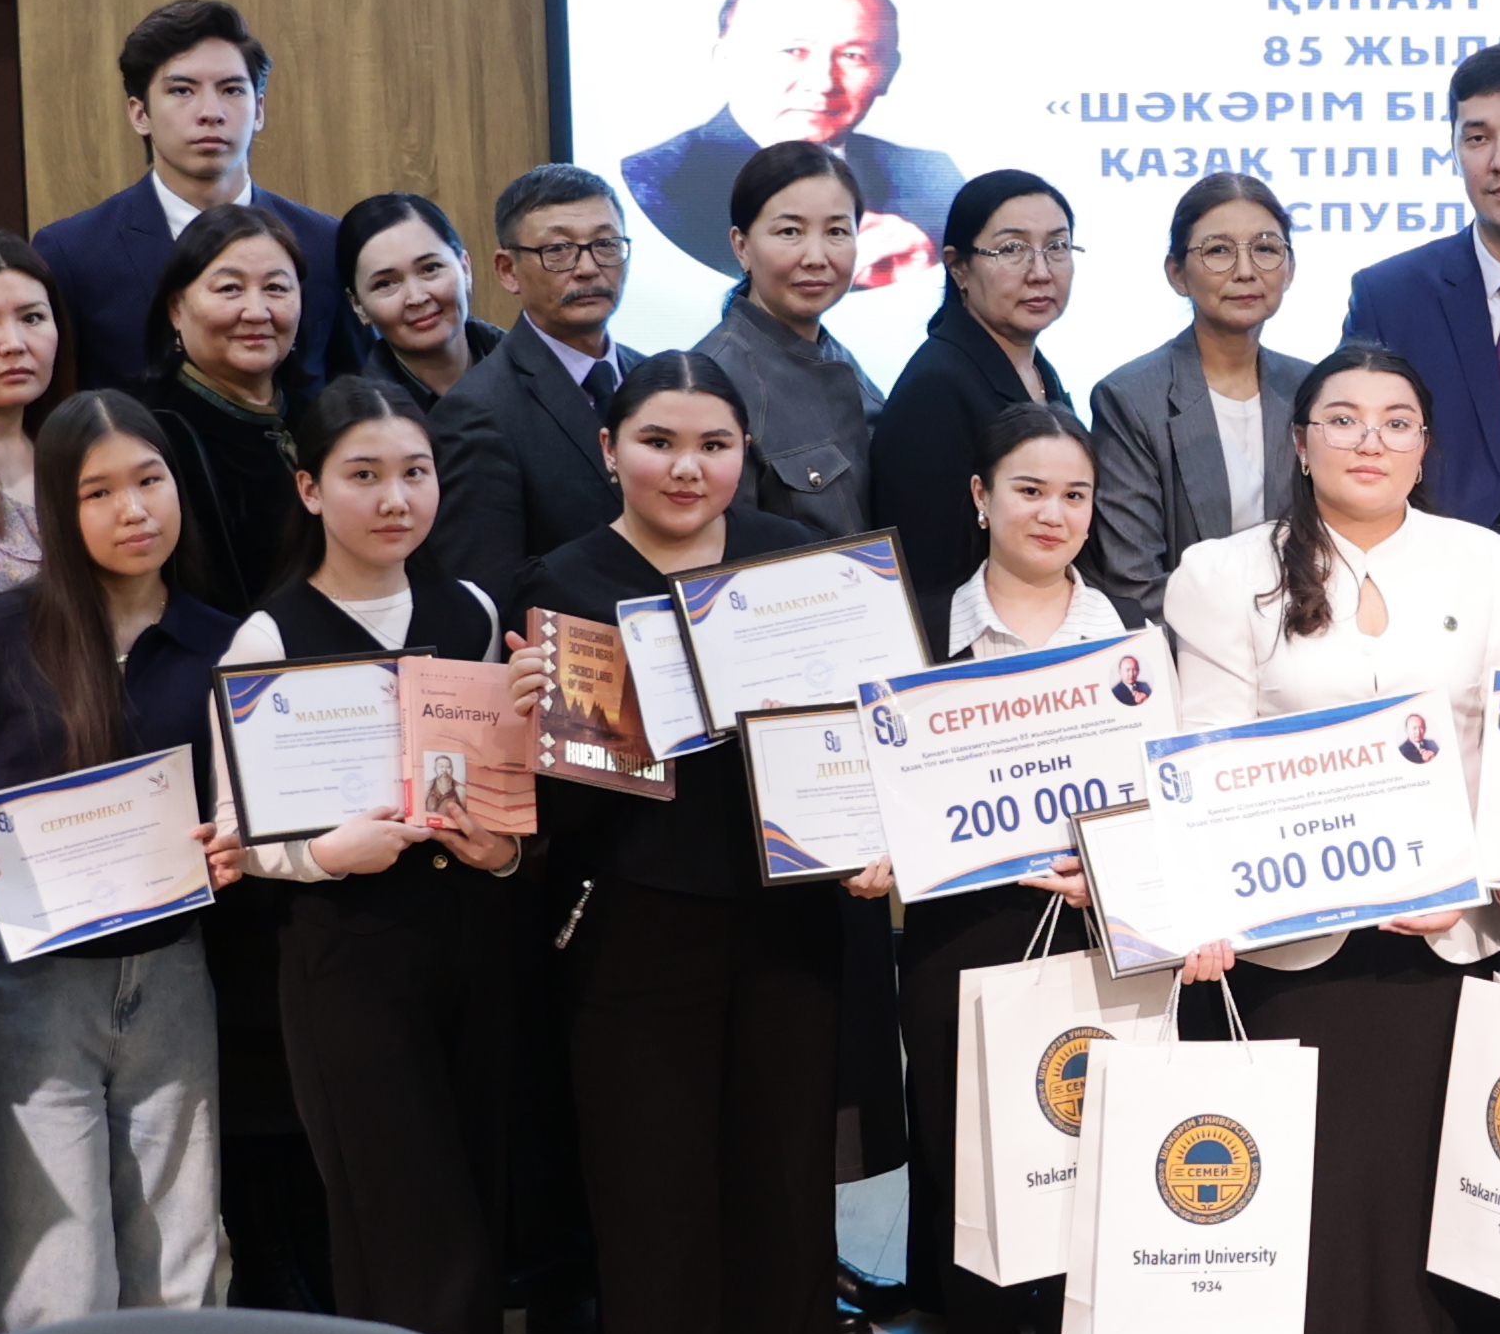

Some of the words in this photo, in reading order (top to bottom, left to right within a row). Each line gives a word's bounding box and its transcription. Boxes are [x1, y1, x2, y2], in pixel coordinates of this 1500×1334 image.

[1263, 35, 1323, 66] 85
[1101, 147, 1272, 182] ҚАЗАҚ
[1290, 147, 1398, 177] ТІЛІ
[753, 591, 839, 617] МАДАҚТАМА
[295, 705, 378, 723] МАДАҚТАМА
[422, 703, 500, 726] Абайтану
[928, 683, 1100, 734] СЕРТИФИКАТ
[1019, 732, 1029, 740] 85
[1099, 723, 1142, 736] олимпиада
[1010, 754, 1073, 779] ОРЫН
[1214, 741, 1386, 792] СЕРТИФИКАТ
[41, 800, 135, 834] СЕРТИФИКАТ
[946, 795, 1021, 842] 200
[1034, 777, 1108, 825] 000
[1293, 813, 1356, 838] ОРЫН
[1231, 852, 1307, 897] 300
[1322, 835, 1396, 882] 000
[1158, 1117, 1199, 1159] ШӘКӘРІМ
[1199, 1114, 1258, 1159] УНИВЕРСИТЕТІ
[1026, 1162, 1077, 1189] Shakari
[1187, 1164, 1229, 1178] СЕМЕЙ
[1133, 1247, 1201, 1266] Shakarim
[1204, 1245, 1277, 1267] University
[1191, 1280, 1223, 1293] 1934
